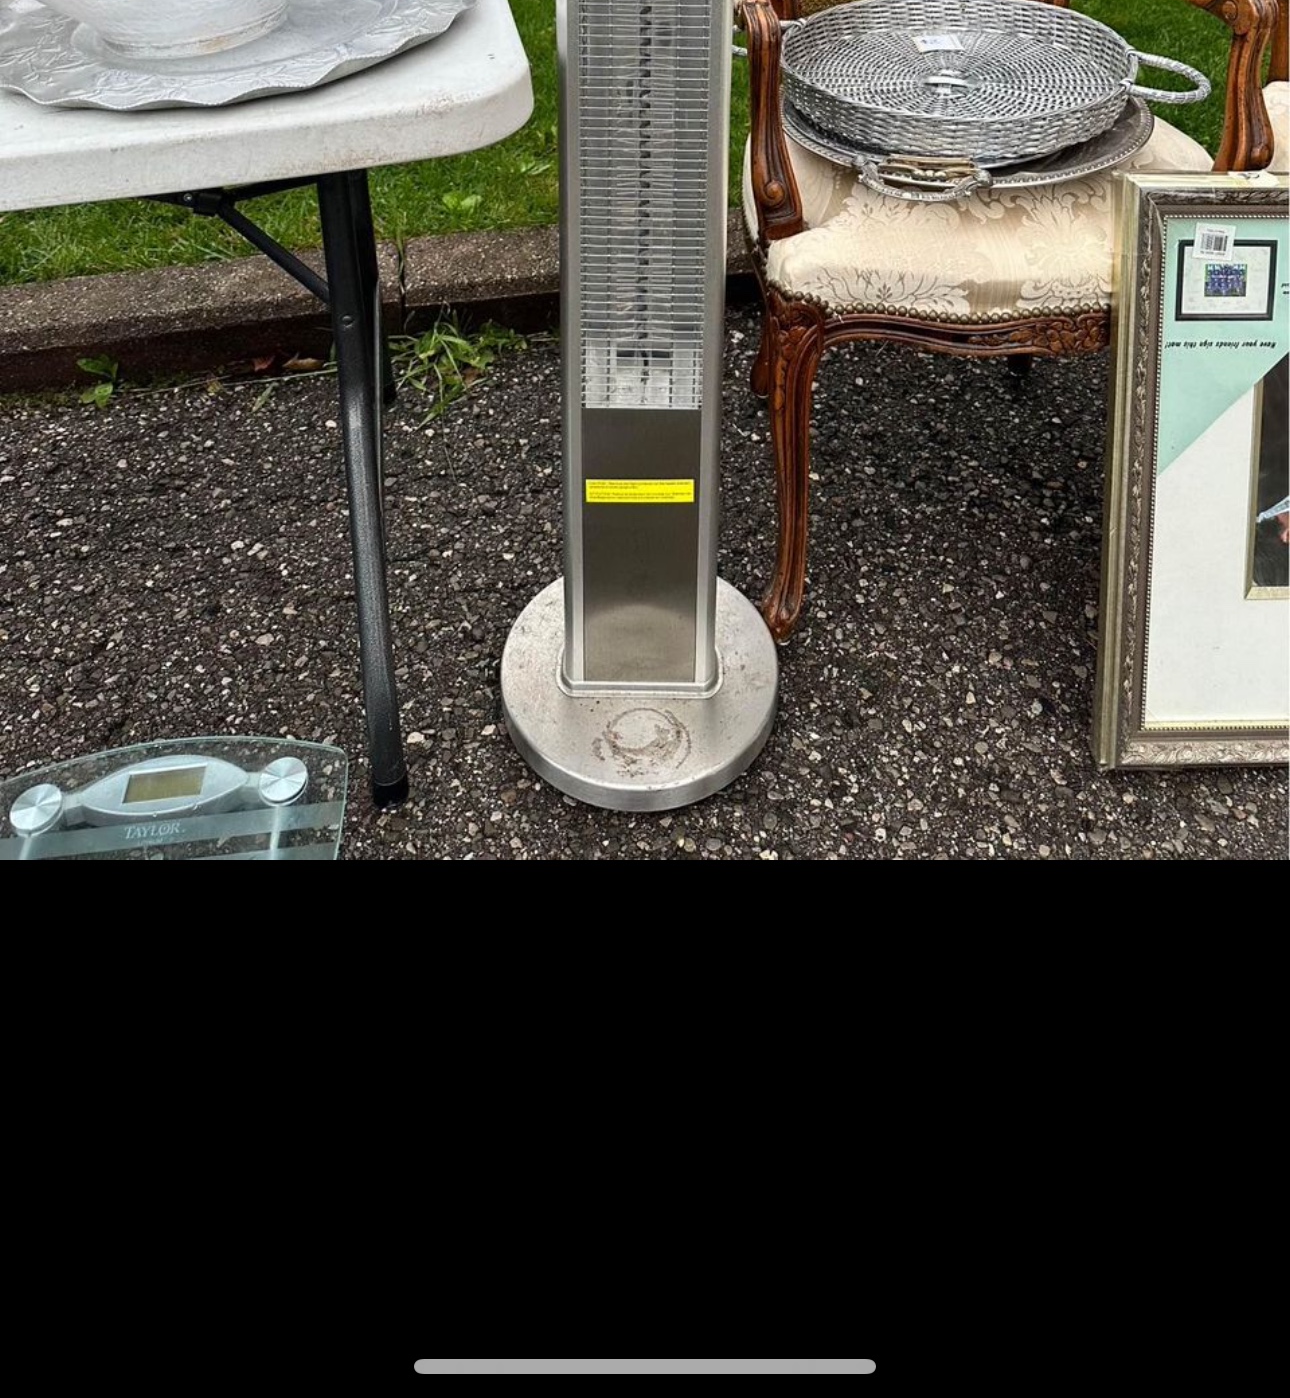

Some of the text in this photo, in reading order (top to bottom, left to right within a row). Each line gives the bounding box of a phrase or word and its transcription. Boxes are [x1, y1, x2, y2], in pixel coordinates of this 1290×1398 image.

[1183, 341, 1197, 349] this
[1199, 339, 1213, 349] sign
[1215, 341, 1240, 349] friends
[1241, 340, 1257, 348] your
[1259, 341, 1277, 349] Have
